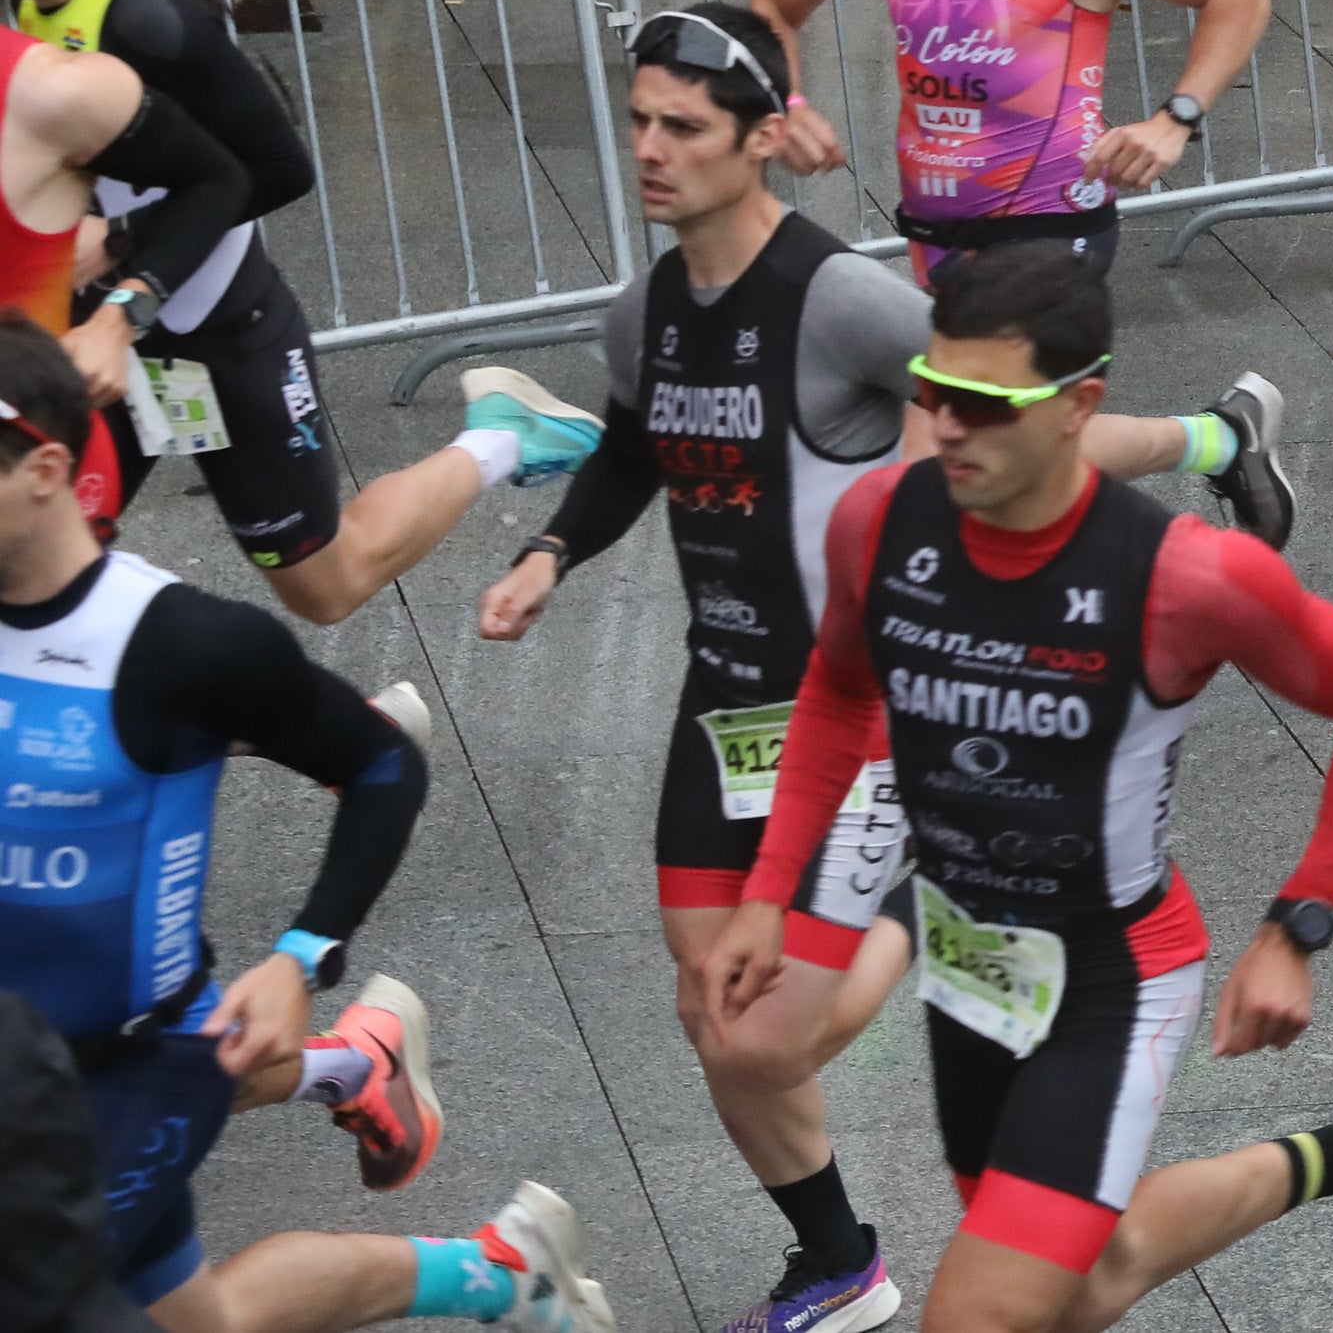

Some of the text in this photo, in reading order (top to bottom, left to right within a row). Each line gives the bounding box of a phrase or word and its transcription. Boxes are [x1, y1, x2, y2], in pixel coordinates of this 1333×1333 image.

[919, 24, 1018, 65] Cotón
[906, 69, 990, 104] SOLÍS
[924, 110, 971, 128] LAU
[648, 382, 765, 442] ESCUDERO
[880, 615, 1028, 664] TRIATLON
[887, 668, 1092, 740] SANTIAGO
